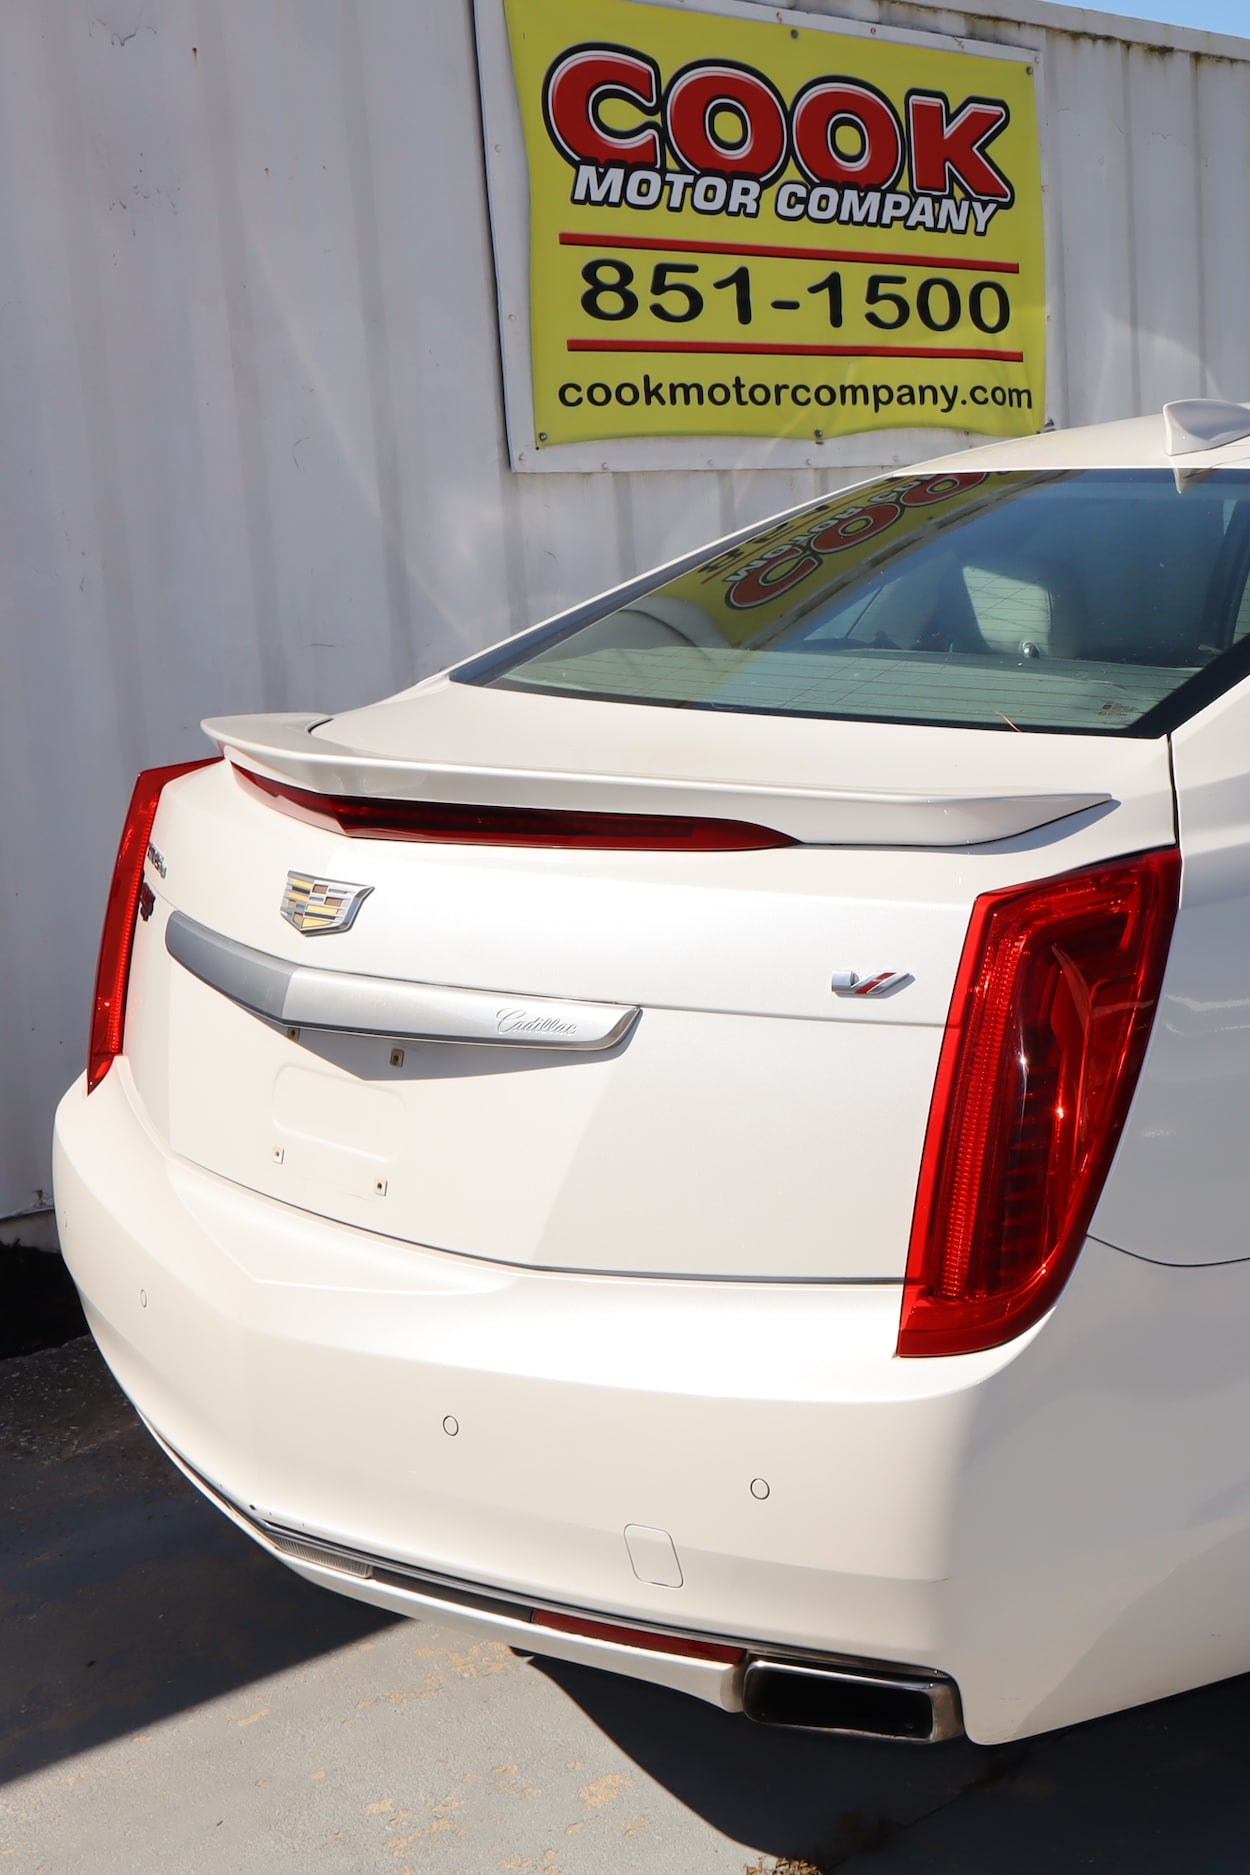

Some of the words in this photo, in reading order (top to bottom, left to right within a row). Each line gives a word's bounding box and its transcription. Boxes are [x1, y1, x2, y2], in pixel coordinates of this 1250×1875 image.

[542, 42, 1016, 208] COOK
[572, 163, 762, 218] MOTOR
[774, 181, 1000, 236] COMPANY
[579, 258, 1011, 334] 851-1500
[557, 374, 1033, 413] cookmotorcompany.com
[495, 1007, 578, 1036] Cadillac
